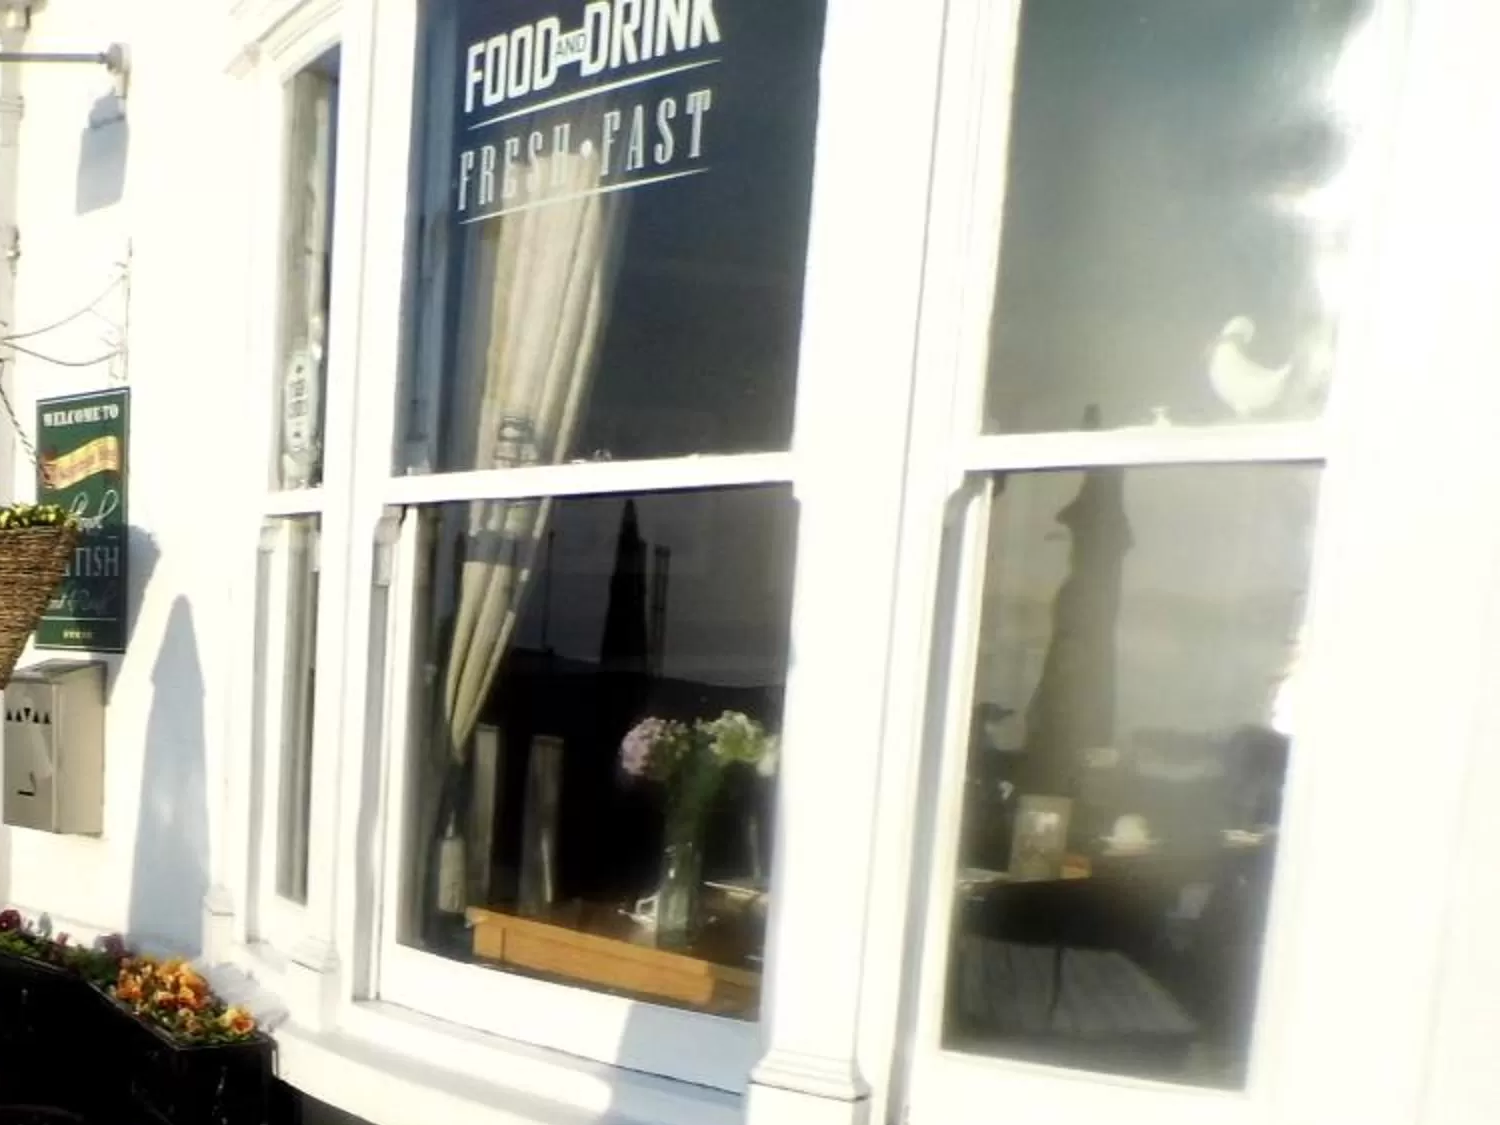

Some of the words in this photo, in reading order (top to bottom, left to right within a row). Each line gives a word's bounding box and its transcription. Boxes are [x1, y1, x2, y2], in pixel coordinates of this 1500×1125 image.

[464, 16, 561, 113] FOOD
[580, 0, 722, 77] DRINK
[458, 123, 571, 211] FRESH
[600, 89, 712, 177] FAST
[43, 406, 102, 427] WELCOME
[101, 403, 119, 421] TO
